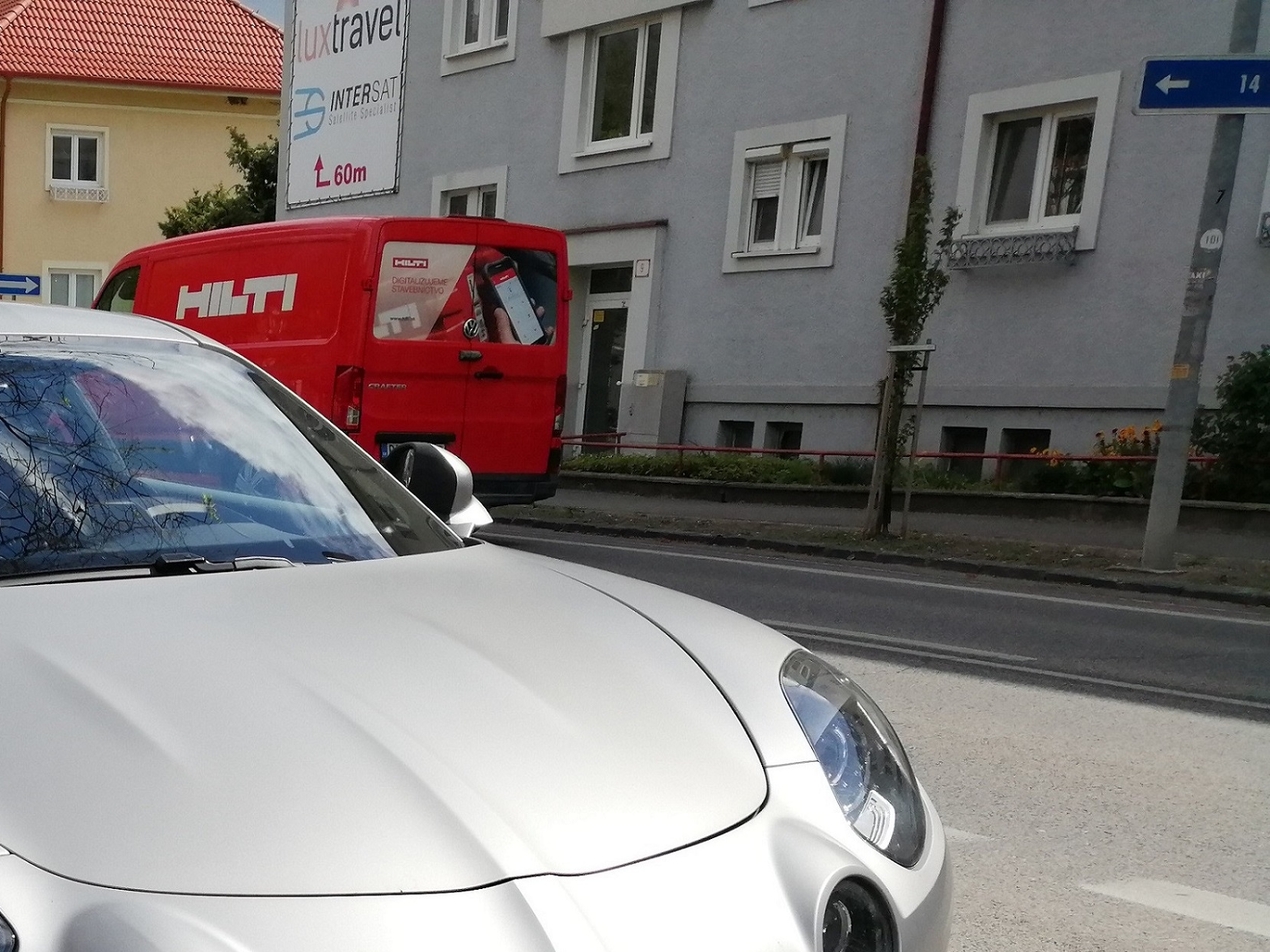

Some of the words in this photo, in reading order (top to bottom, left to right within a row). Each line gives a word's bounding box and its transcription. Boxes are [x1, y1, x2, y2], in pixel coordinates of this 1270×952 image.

[297, 0, 401, 62] luxtravel
[330, 76, 399, 112] INTERSAT
[328, 109, 358, 126] Satellite
[360, 102, 397, 120] Specialist
[334, 163, 367, 186] 60m
[394, 259, 427, 267] HILTI
[176, 273, 298, 320] HILTI
